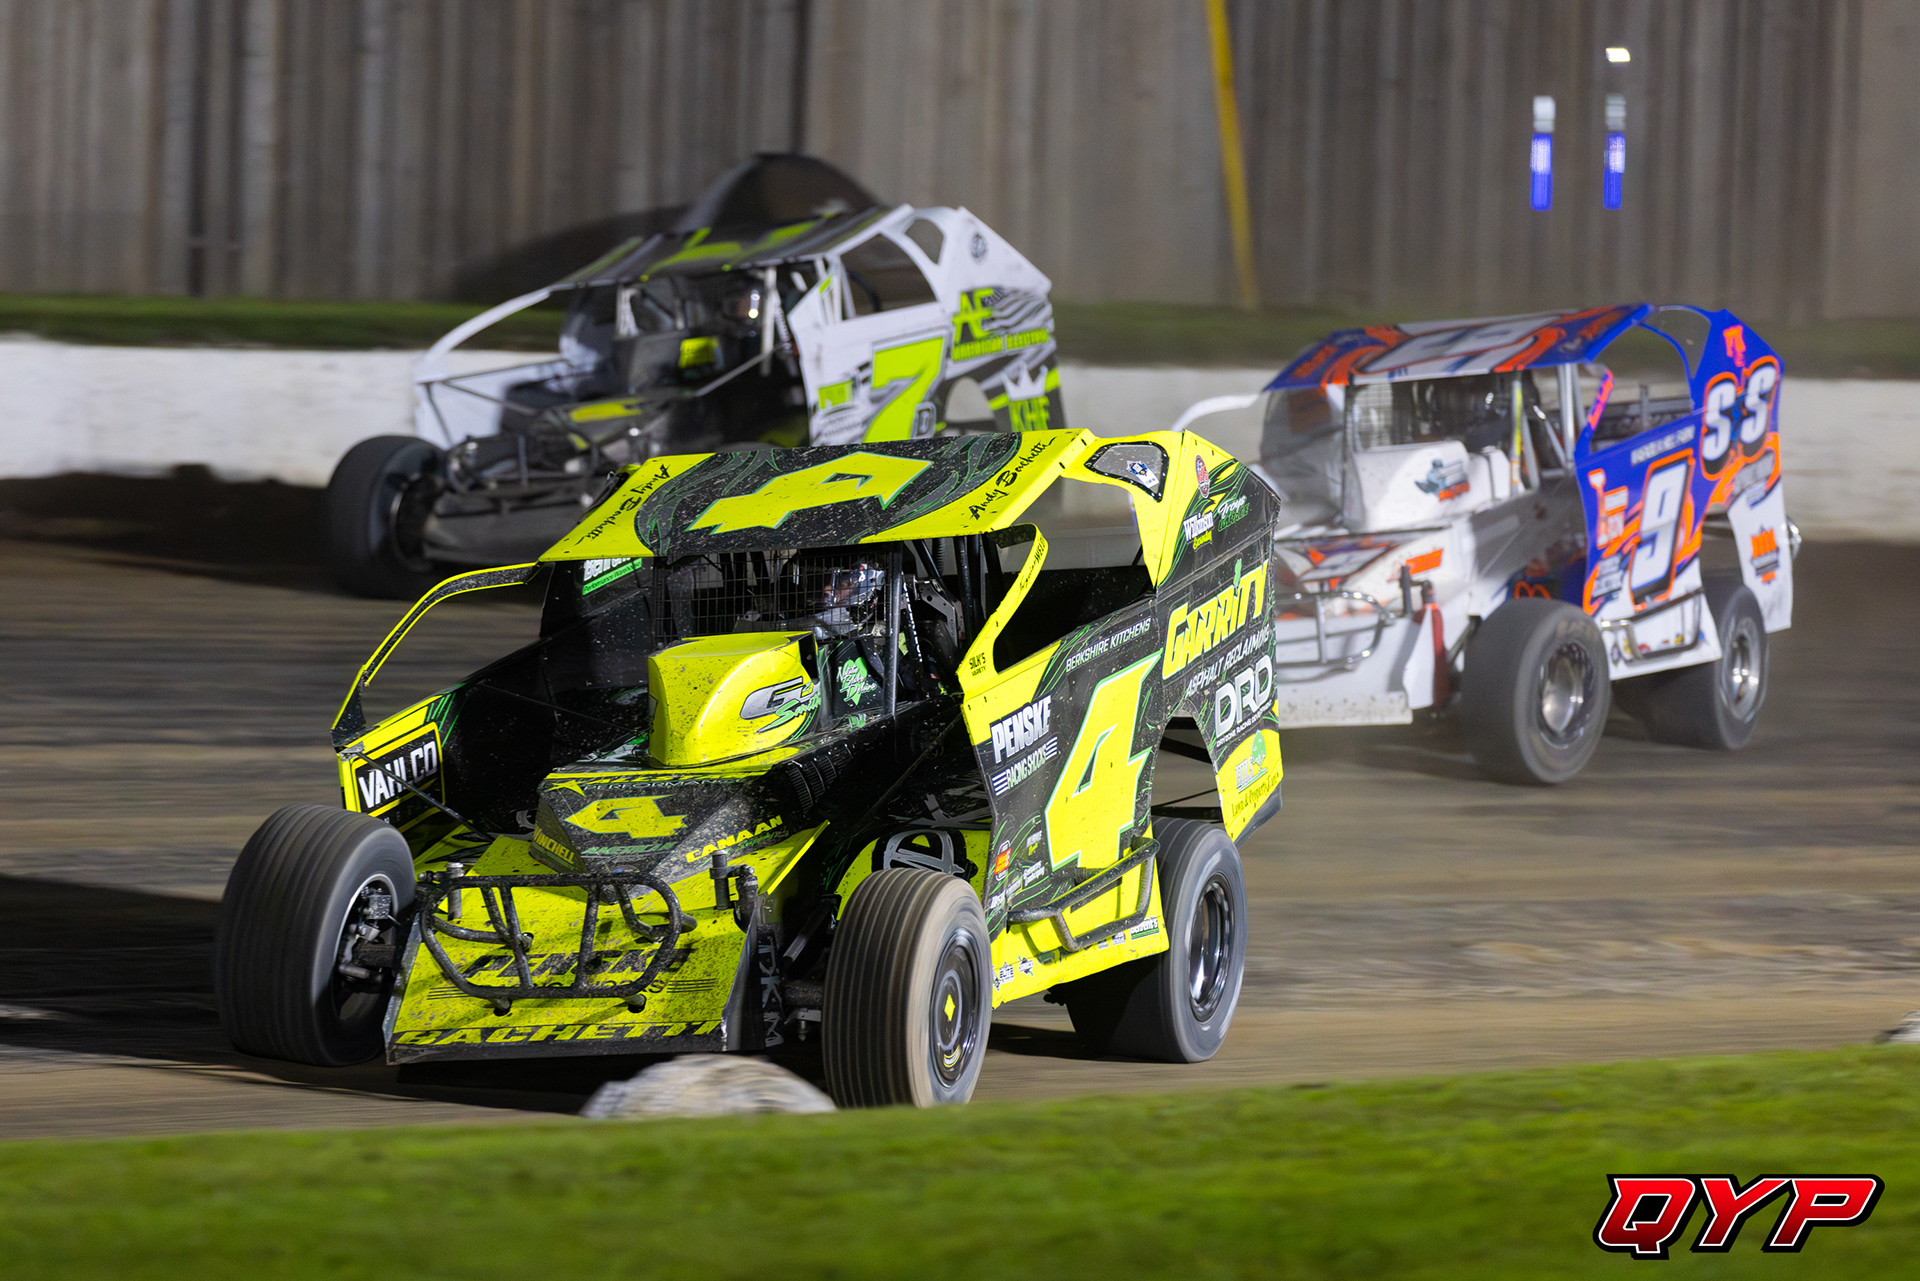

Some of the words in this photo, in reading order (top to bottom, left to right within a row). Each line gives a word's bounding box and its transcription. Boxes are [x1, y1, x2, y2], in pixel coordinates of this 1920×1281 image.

[862, 336, 944, 443] 7
[630, 464, 671, 494] Andy
[969, 488, 1009, 520] Andy
[1630, 457, 1691, 597] 9
[1066, 638, 1109, 673] BERKSHIRE
[1109, 617, 1151, 651] KITCHENS
[1185, 656, 1224, 699] ASPHALT
[1215, 655, 1273, 739] DRD
[991, 695, 1051, 764] PENSKE
[1006, 759, 1028, 789] RACING
[1027, 744, 1047, 777] SHOCKS
[1044, 648, 1163, 872] 4
[686, 815, 783, 863] CANAAN
